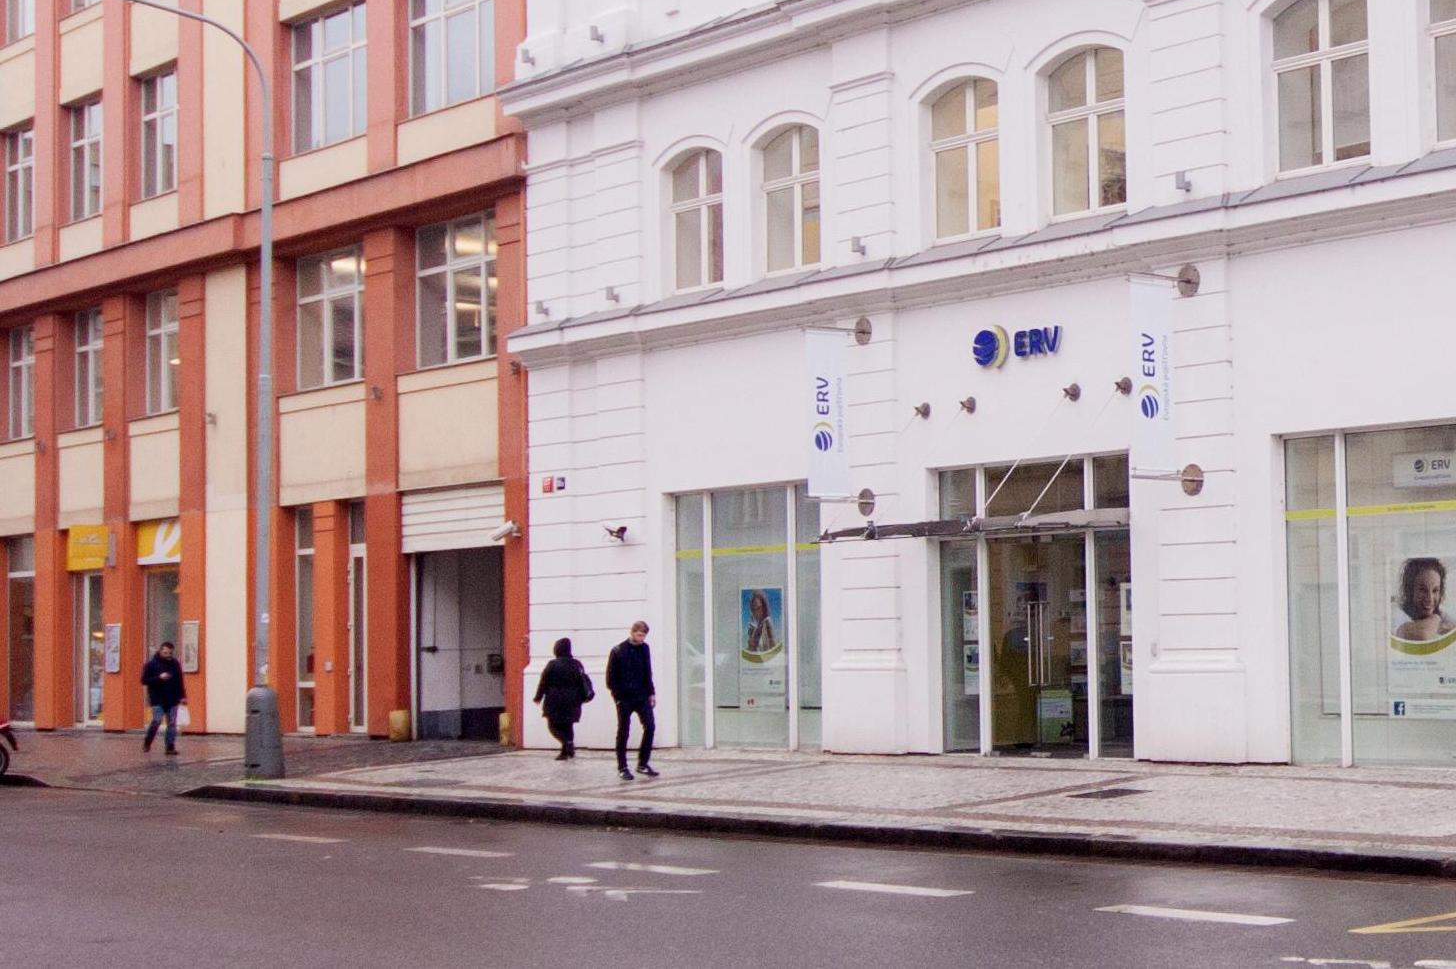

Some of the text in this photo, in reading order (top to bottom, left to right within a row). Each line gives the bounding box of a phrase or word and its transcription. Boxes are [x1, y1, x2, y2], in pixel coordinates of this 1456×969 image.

[1014, 325, 1063, 358] ERV
[1141, 332, 1156, 378] ERV
[815, 375, 830, 416] ERV
[1431, 459, 1451, 470] ERV
